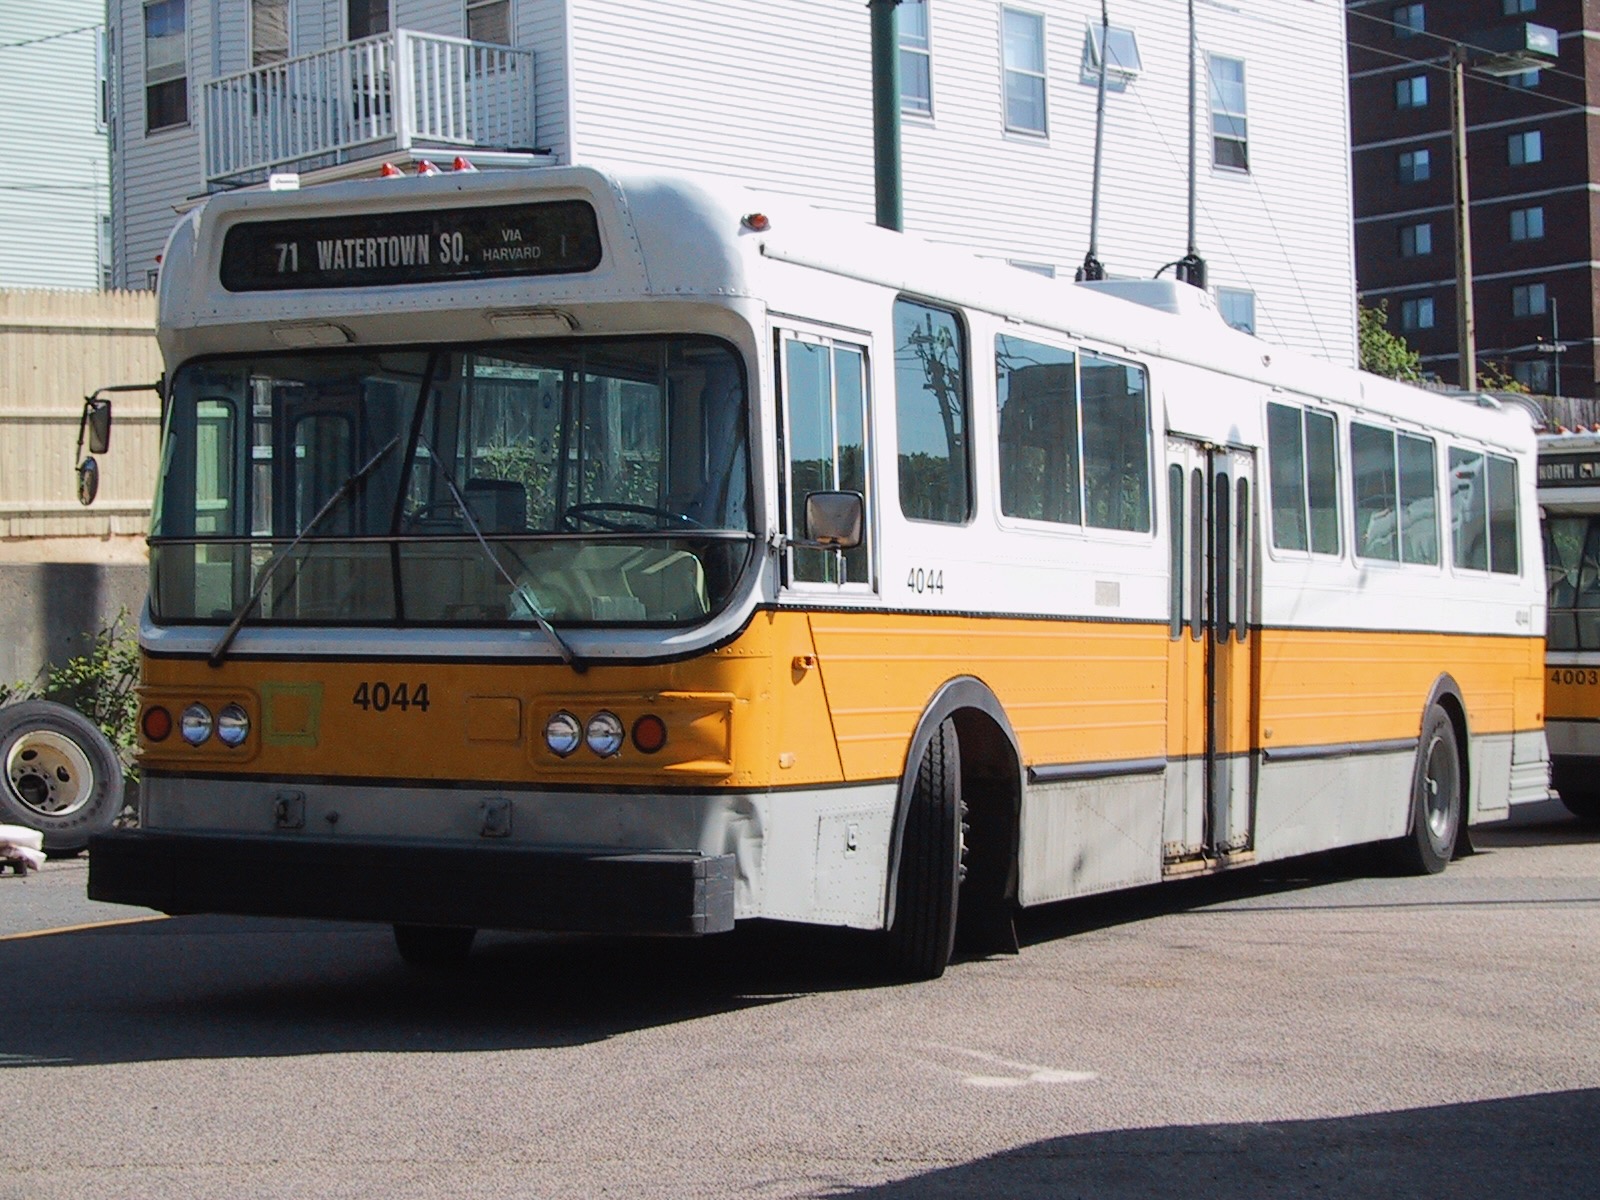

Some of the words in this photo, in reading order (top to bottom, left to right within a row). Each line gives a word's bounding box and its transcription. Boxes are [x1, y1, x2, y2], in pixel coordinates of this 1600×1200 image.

[502, 228, 523, 242] VIA
[275, 243, 298, 273] 71
[317, 234, 430, 270] WATERTOWN
[440, 231, 469, 265] SQ.
[482, 246, 541, 262] HARVARD
[1539, 463, 1575, 480] NORTH
[906, 567, 944, 595] 4044
[1551, 669, 1598, 685] 4003
[353, 682, 430, 712] 4044
